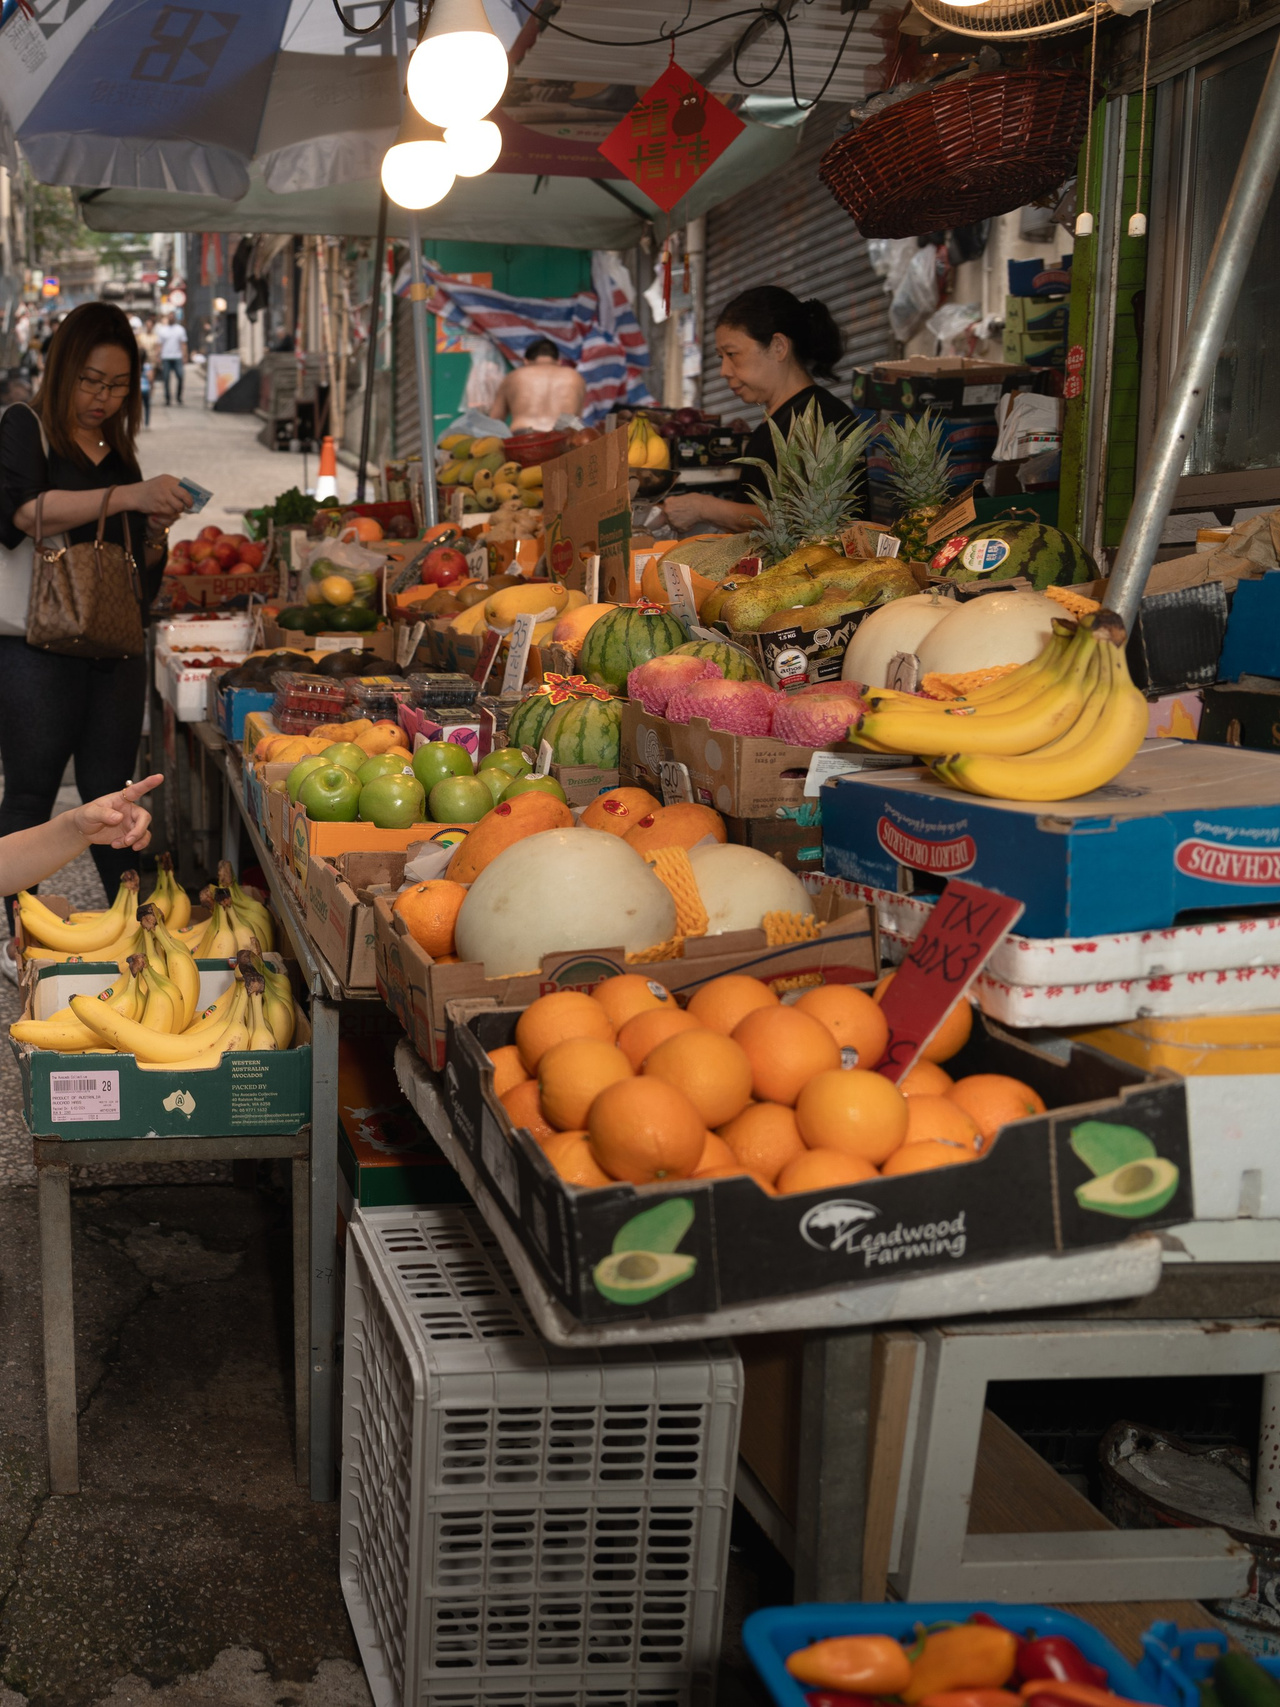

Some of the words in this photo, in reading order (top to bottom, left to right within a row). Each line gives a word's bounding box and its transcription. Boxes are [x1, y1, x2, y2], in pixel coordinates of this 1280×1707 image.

[780, 664, 802, 675] athos
[882, 821, 929, 866] ORCHARDS
[1193, 819, 1239, 841] Australia
[930, 839, 969, 868] DELROY
[102, 1080, 112, 1092] 28
[846, 1209, 967, 1255] Leadwood
[863, 1234, 967, 1268] Farming
